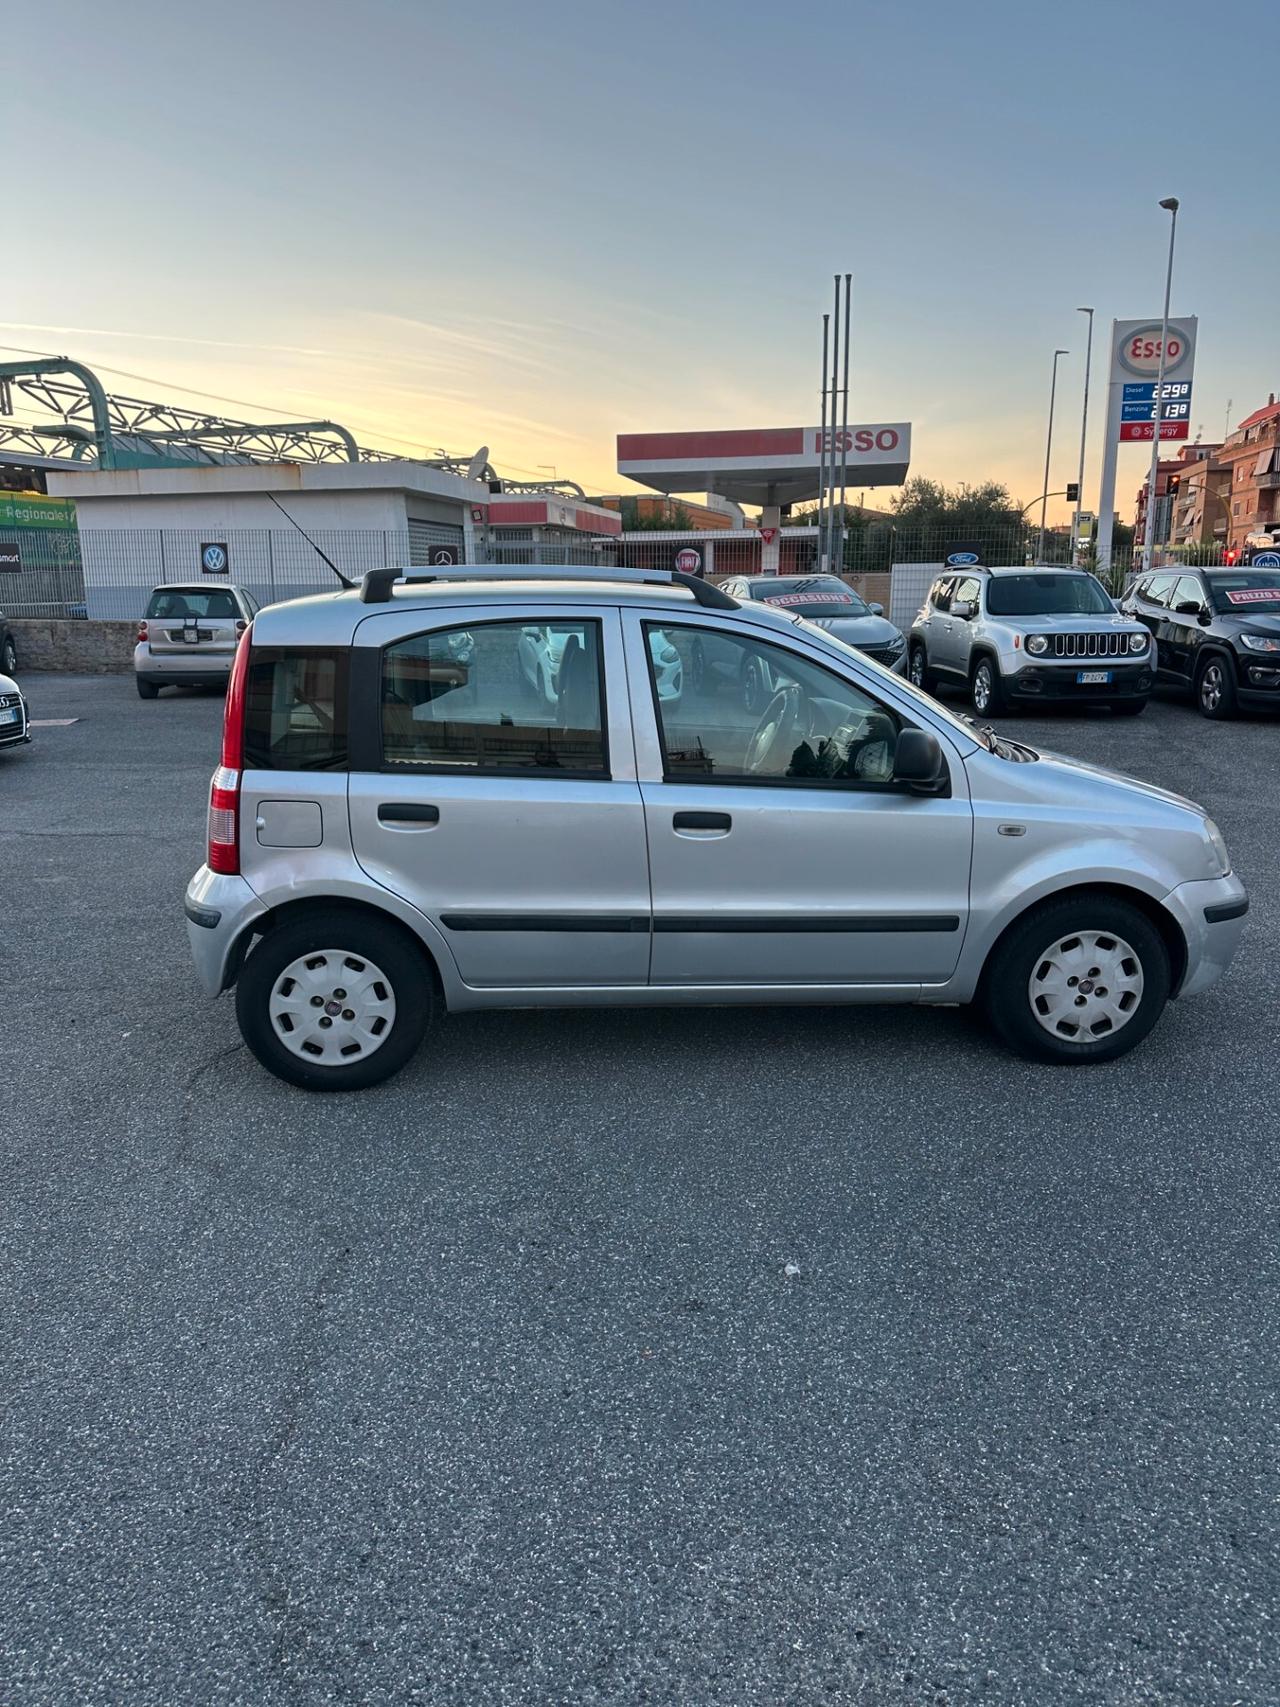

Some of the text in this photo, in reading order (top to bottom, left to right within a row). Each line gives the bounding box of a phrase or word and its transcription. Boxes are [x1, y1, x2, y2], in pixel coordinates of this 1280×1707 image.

[1131, 337, 1180, 358] Esso
[1144, 427, 1178, 437] Syergy
[815, 429, 899, 454] ESSO
[6, 505, 65, 522] Regionale
[770, 593, 849, 606] OCCASIONE
[1233, 592, 1273, 601] PREZZO
